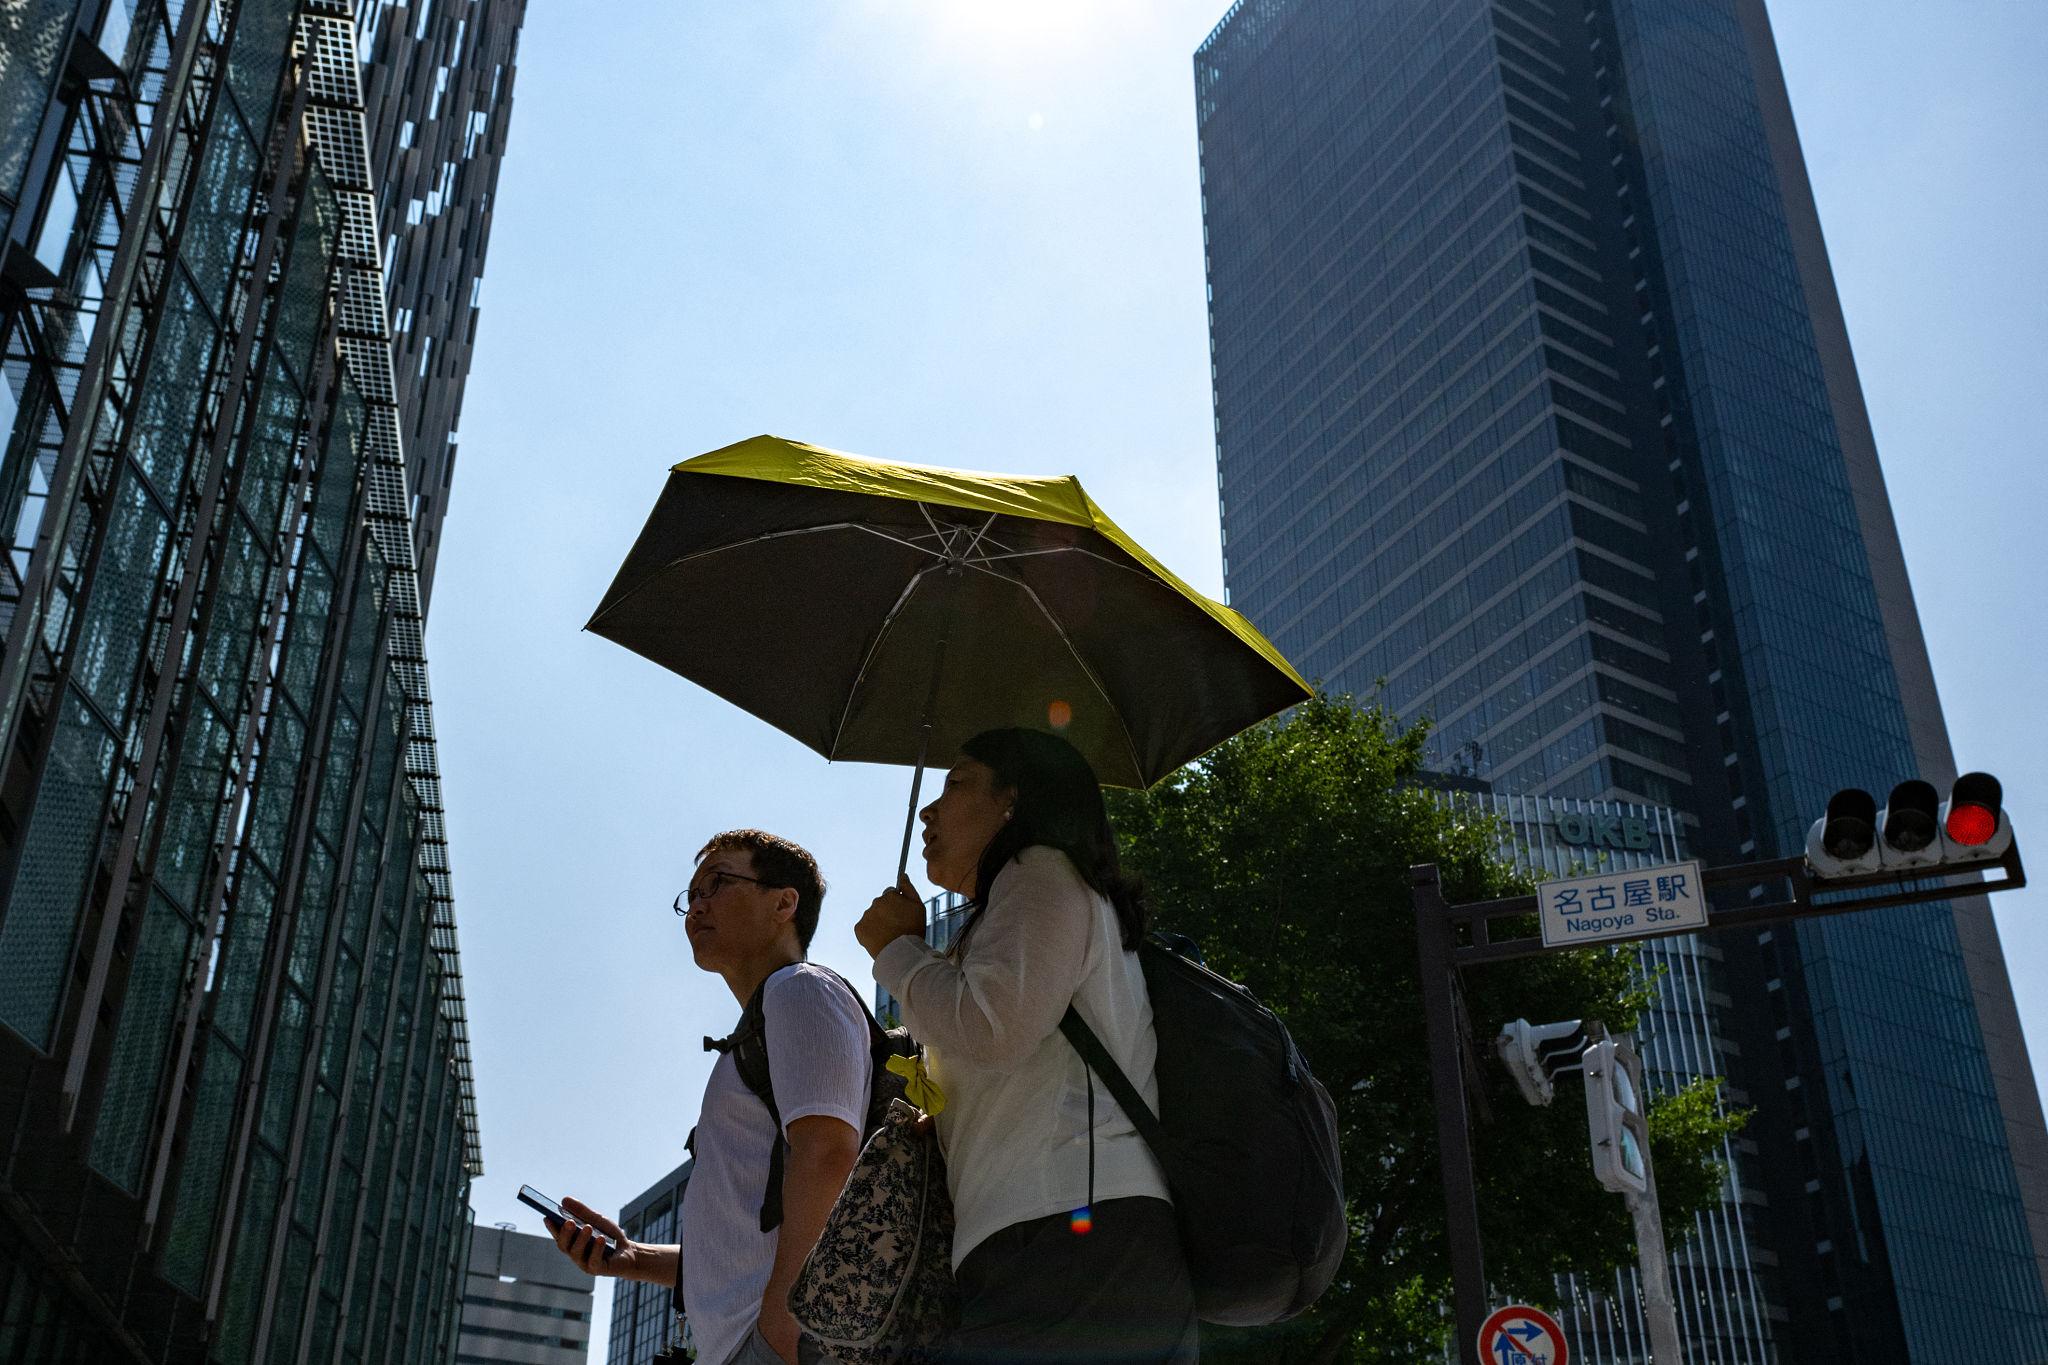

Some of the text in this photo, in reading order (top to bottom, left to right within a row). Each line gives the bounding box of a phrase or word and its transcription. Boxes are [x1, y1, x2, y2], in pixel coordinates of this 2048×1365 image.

[1558, 813, 1651, 849] OKB
[1553, 874, 1690, 915] 名古屋駅
[1566, 906, 1681, 933] Nagoya Sta.
